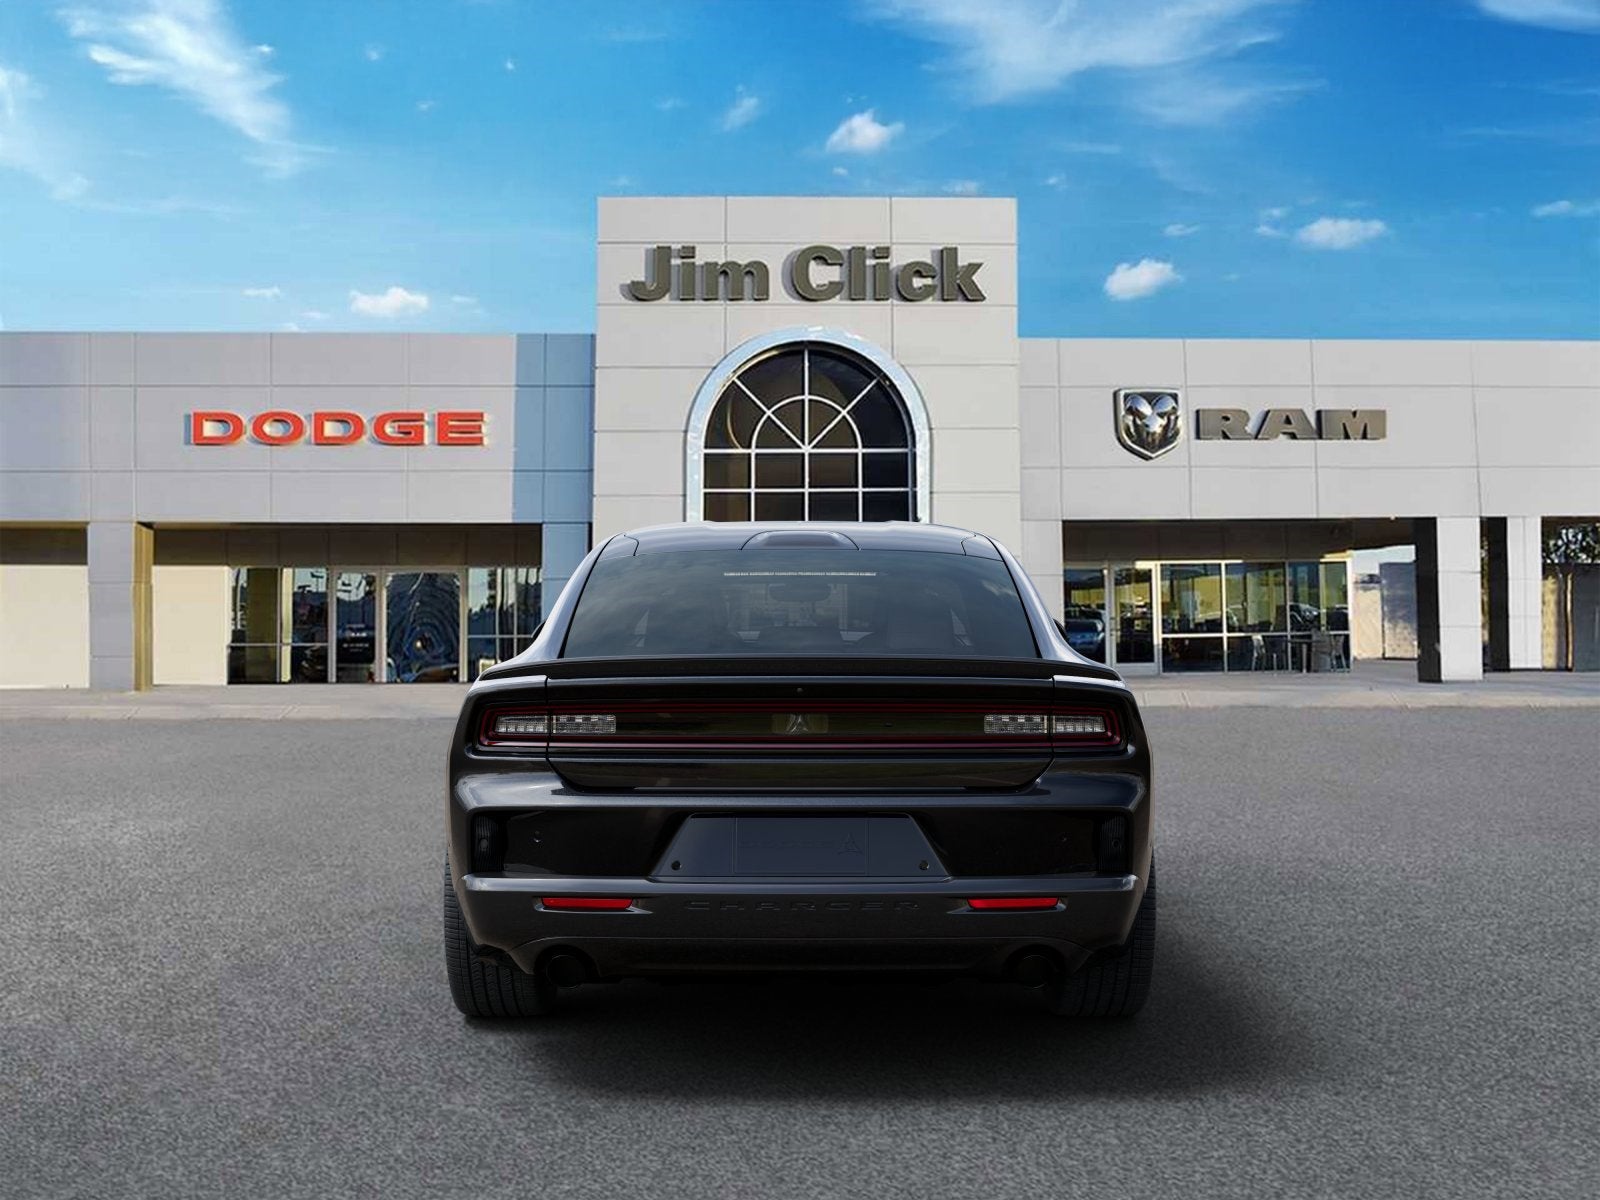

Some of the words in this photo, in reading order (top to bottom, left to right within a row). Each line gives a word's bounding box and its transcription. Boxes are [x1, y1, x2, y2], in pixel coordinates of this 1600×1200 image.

[627, 245, 770, 301] Jim
[789, 244, 987, 301] Click
[190, 410, 487, 446] DODGE
[1195, 408, 1387, 440] RAM
[687, 901, 921, 911] CHARGER
